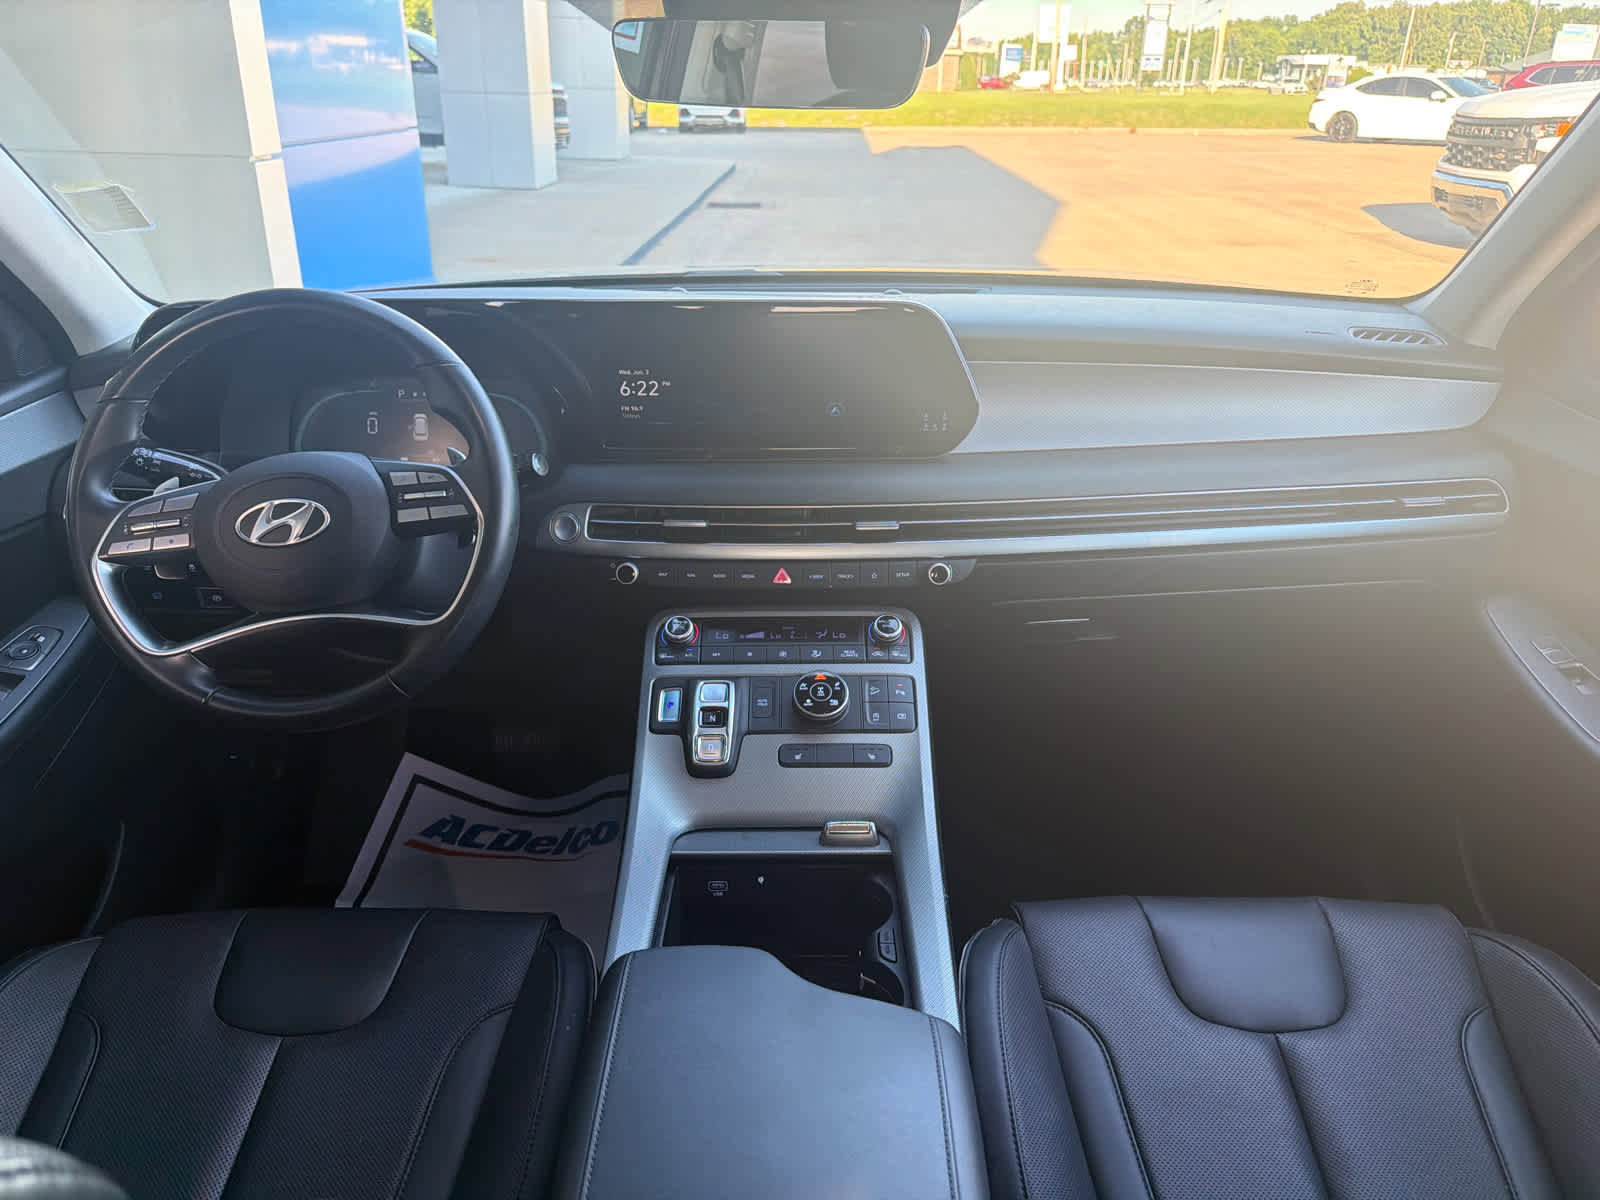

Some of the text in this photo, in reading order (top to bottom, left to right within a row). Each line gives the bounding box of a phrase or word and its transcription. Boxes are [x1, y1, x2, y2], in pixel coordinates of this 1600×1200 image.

[620, 380, 659, 397] 6:22
[709, 711, 717, 722] N
[418, 814, 620, 856] ACDelco
